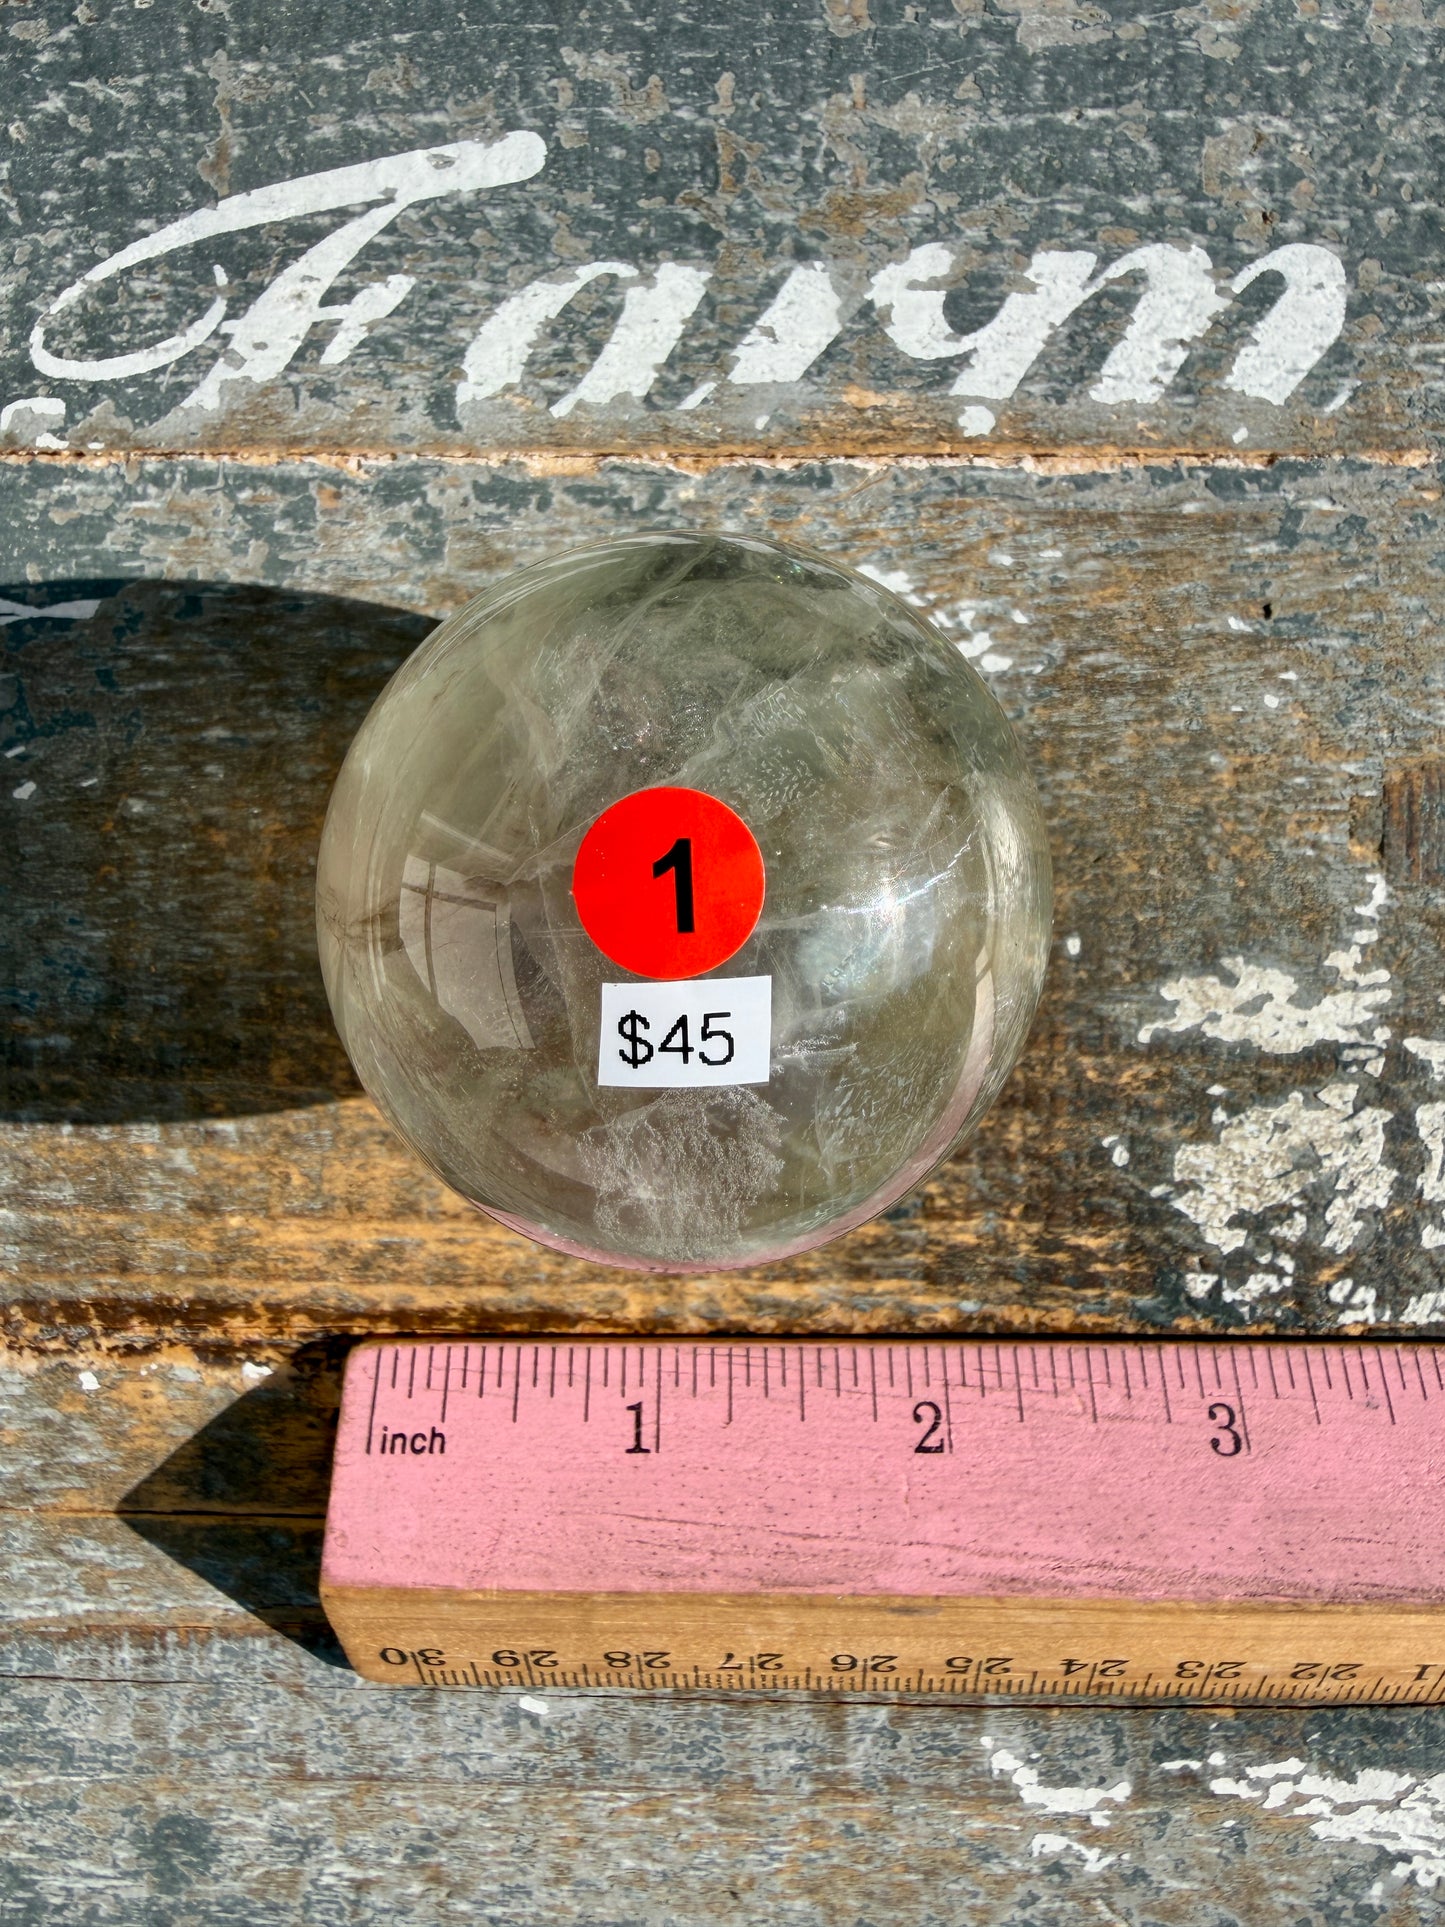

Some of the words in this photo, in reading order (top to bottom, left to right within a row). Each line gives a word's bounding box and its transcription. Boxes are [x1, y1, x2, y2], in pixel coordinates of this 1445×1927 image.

[653, 838, 695, 933] 1
[617, 1009, 734, 1069] $45
[380, 1426, 446, 1455] inch
[625, 1401, 650, 1453] 1
[913, 1401, 944, 1453] 2
[1208, 1403, 1242, 1456] 3
[379, 1647, 447, 1666] 30
[491, 1649, 559, 1668] 29
[604, 1650, 671, 1669] 28
[718, 1652, 784, 1671] 27
[831, 1654, 898, 1673] 26
[945, 1656, 1014, 1675] 25
[1060, 1659, 1130, 1677] 24
[1176, 1660, 1247, 1679] 23
[1290, 1662, 1364, 1681] 22
[1413, 1663, 1445, 1682] 1
